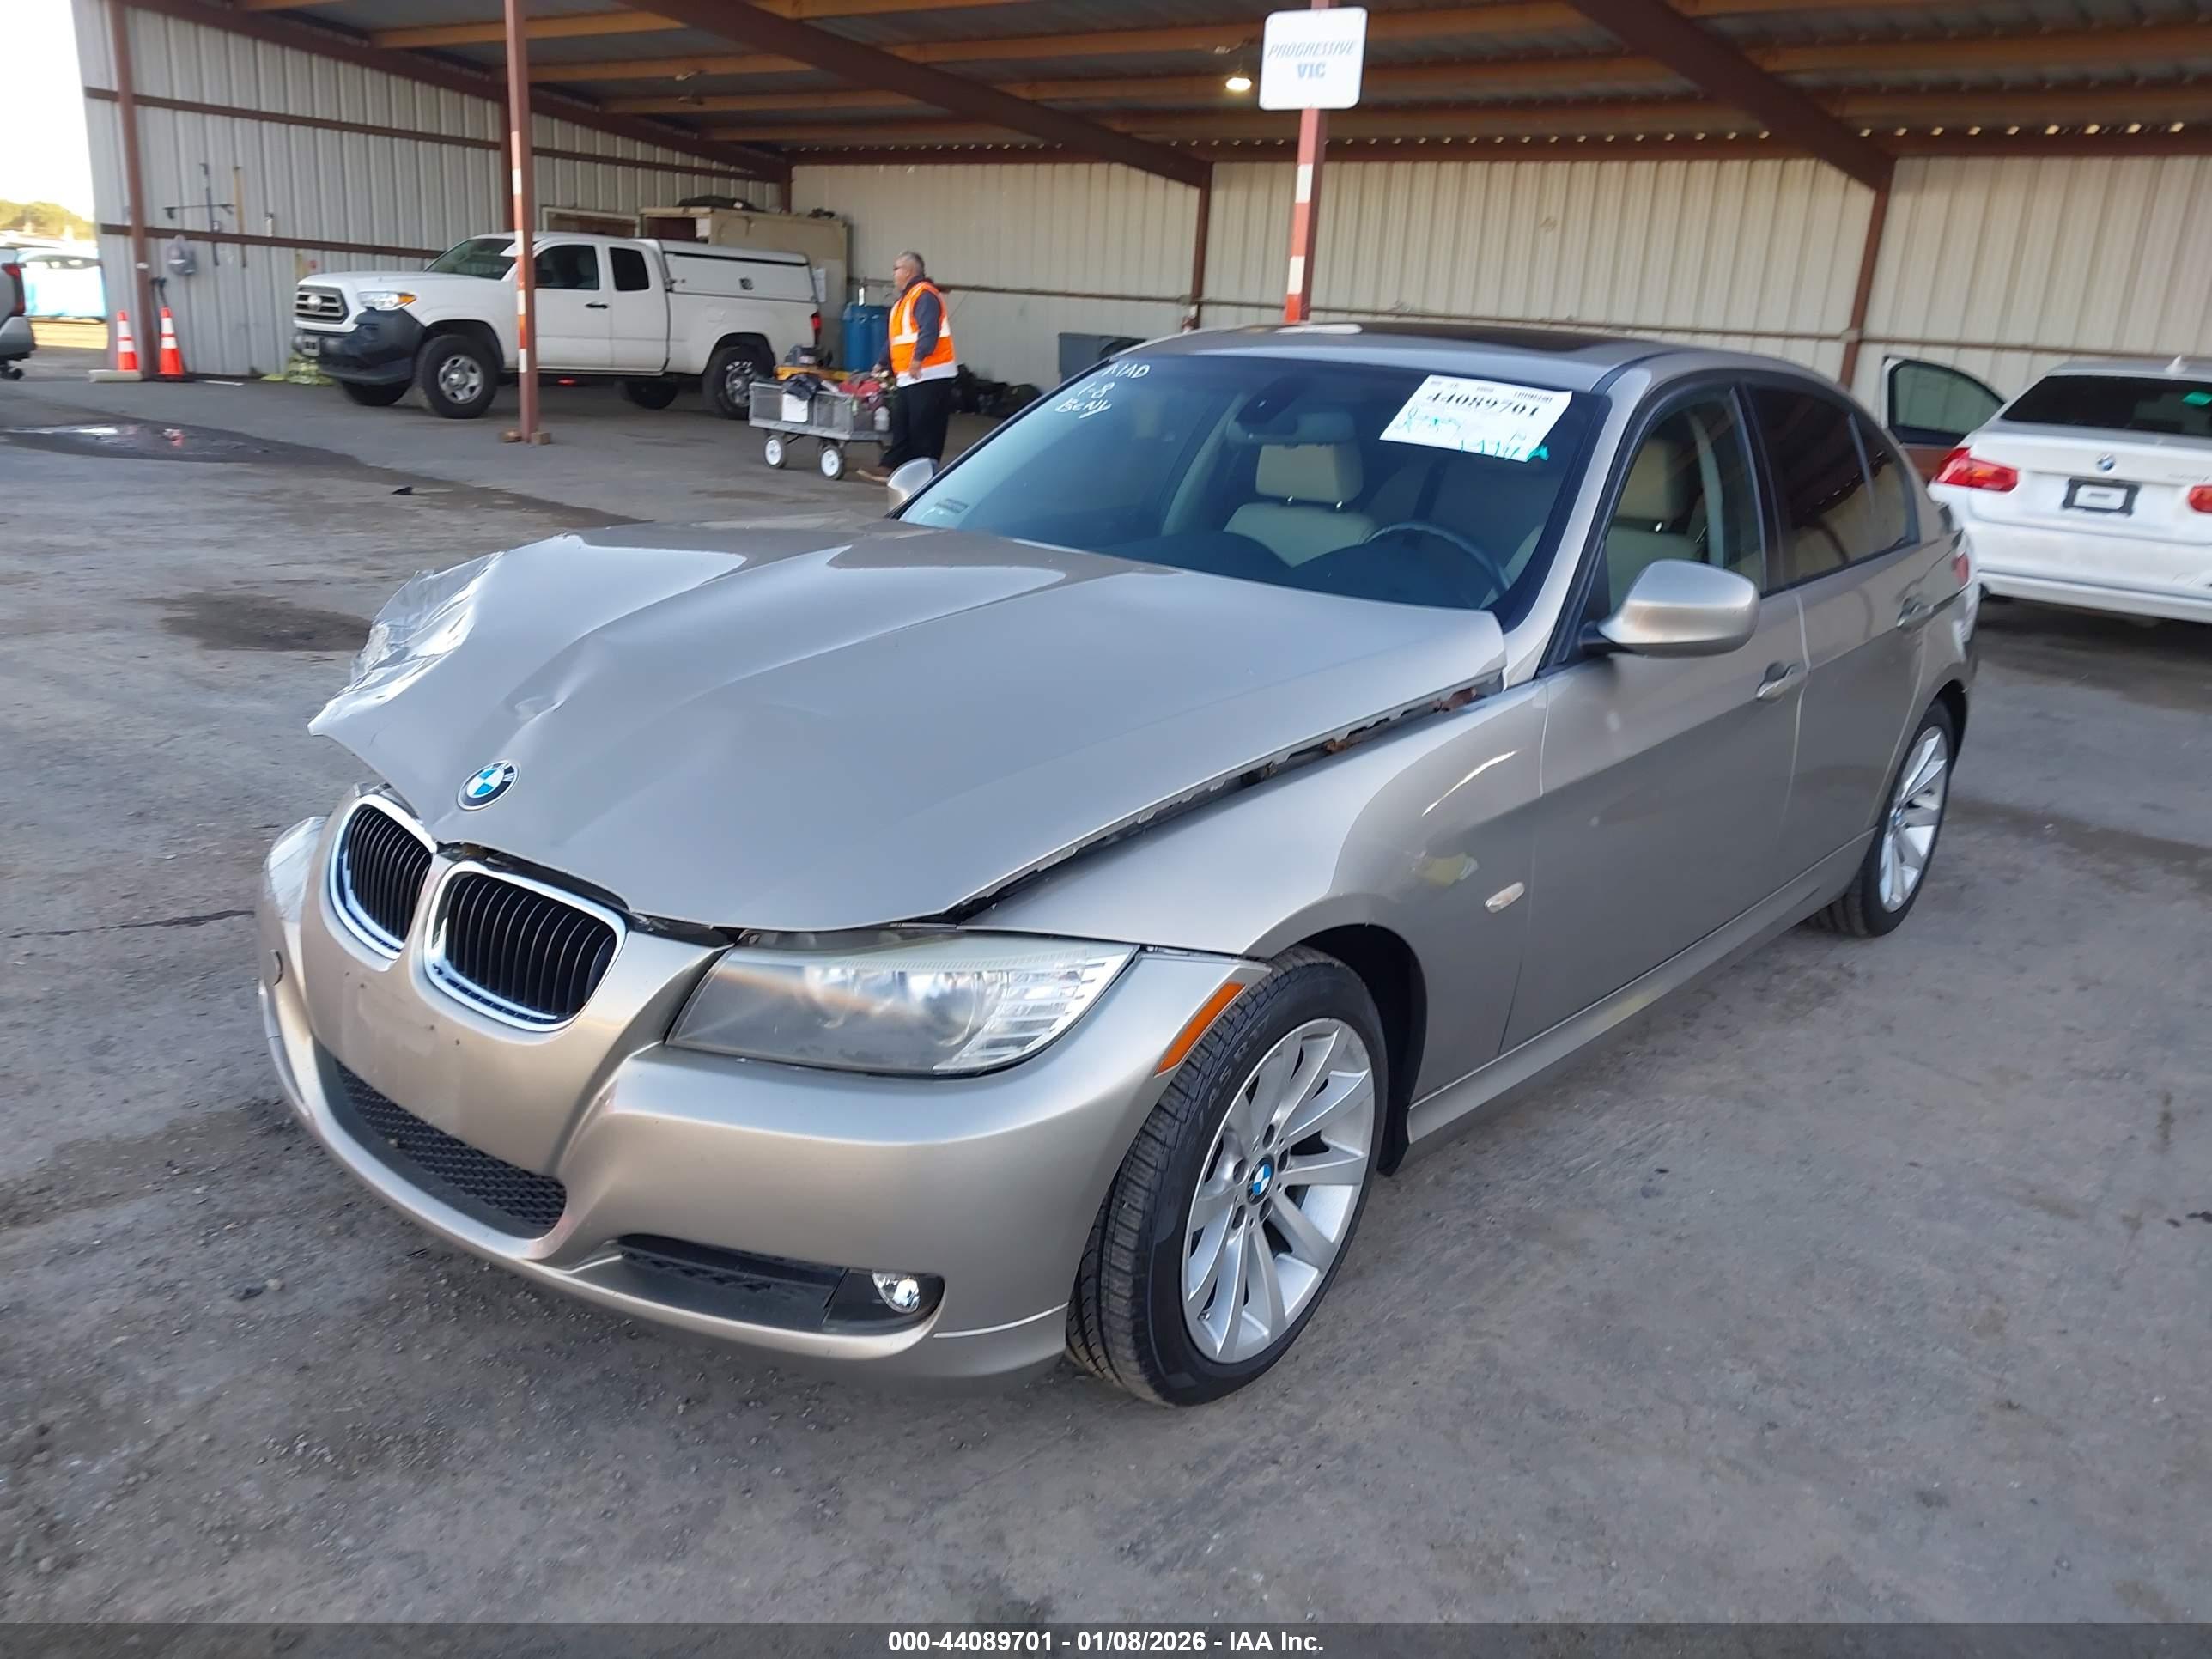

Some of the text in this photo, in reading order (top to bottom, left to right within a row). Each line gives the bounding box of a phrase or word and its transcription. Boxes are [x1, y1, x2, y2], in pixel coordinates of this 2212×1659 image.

[1267, 40, 1358, 59] PROGRESSIVE
[1297, 61, 1327, 79] VIC
[1426, 390, 1540, 418] 44089701
